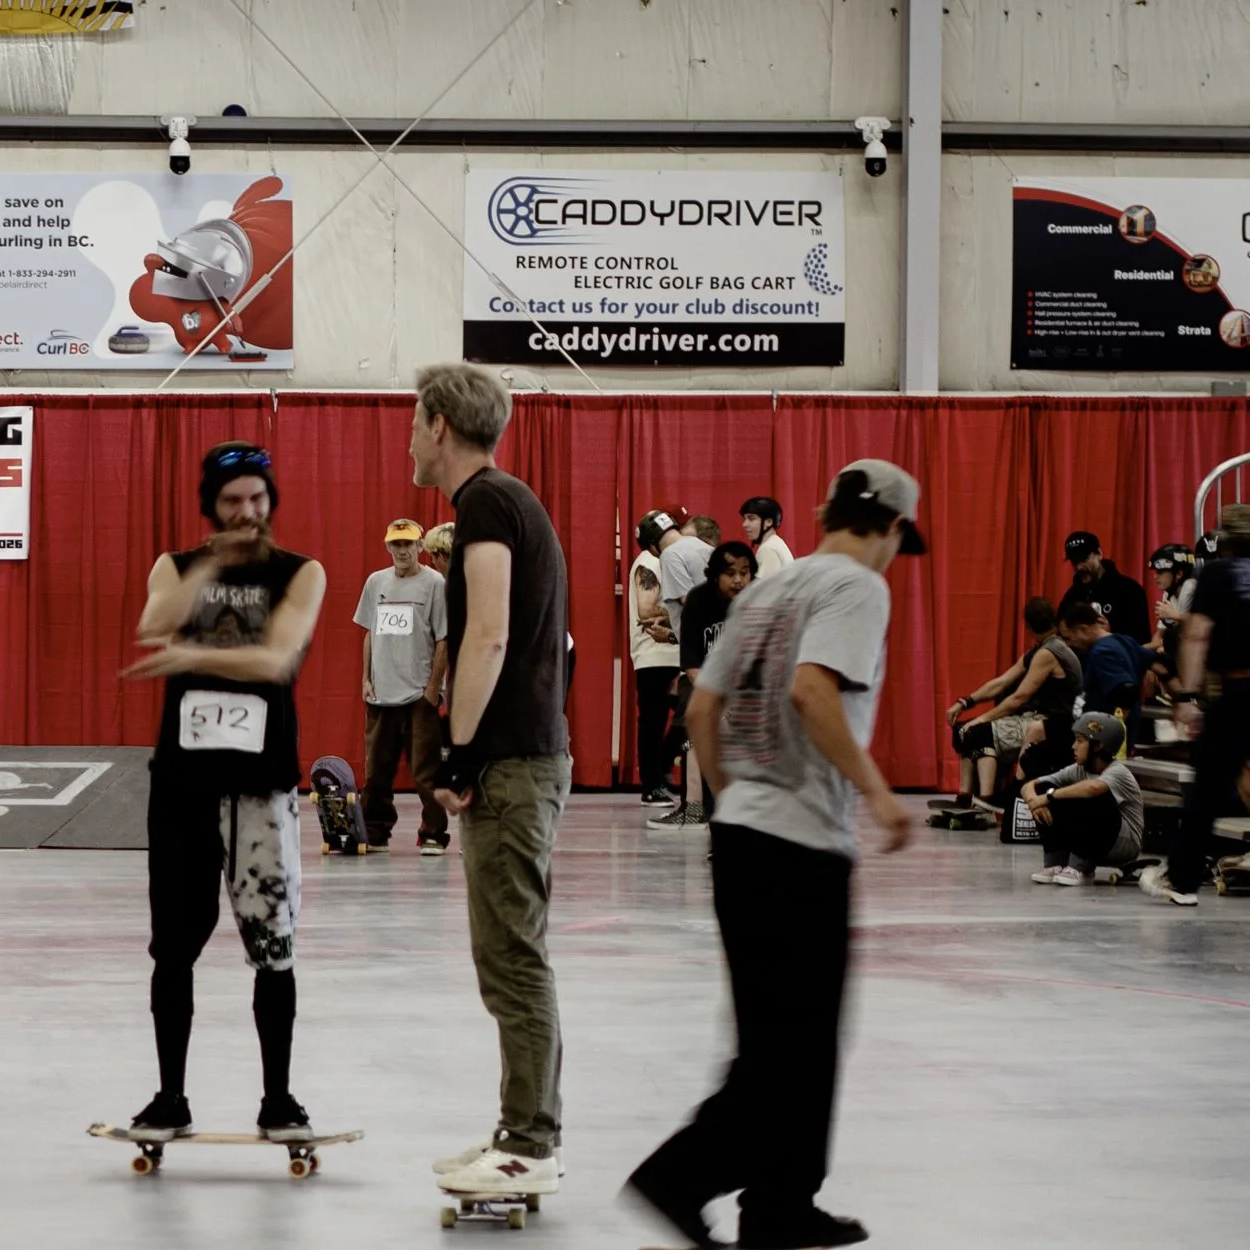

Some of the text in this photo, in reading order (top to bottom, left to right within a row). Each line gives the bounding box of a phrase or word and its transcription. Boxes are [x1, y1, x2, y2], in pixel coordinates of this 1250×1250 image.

[4, 199, 39, 208] save
[44, 199, 64, 208] on
[533, 199, 823, 226] CADDYDRIVER
[2, 215, 32, 228] and
[37, 215, 71, 230] help
[1047, 224, 1112, 234] Commercial
[48, 235, 62, 247] in
[67, 236, 94, 247] BC.
[516, 256, 679, 270] REMOTE CONTROL
[1114, 270, 1174, 280] Residential
[574, 276, 796, 290] ELECTRIC GOLF BAG CART
[572, 301, 594, 314] us
[599, 298, 628, 315] for
[634, 302, 681, 318] your
[685, 298, 726, 316] club
[731, 298, 820, 317] discount!
[1178, 325, 1211, 336] Strata
[36, 342, 90, 355] Curl BC
[528, 327, 779, 357] caddydriver.com
[381, 613, 408, 628] 706
[191, 703, 250, 731] 512
